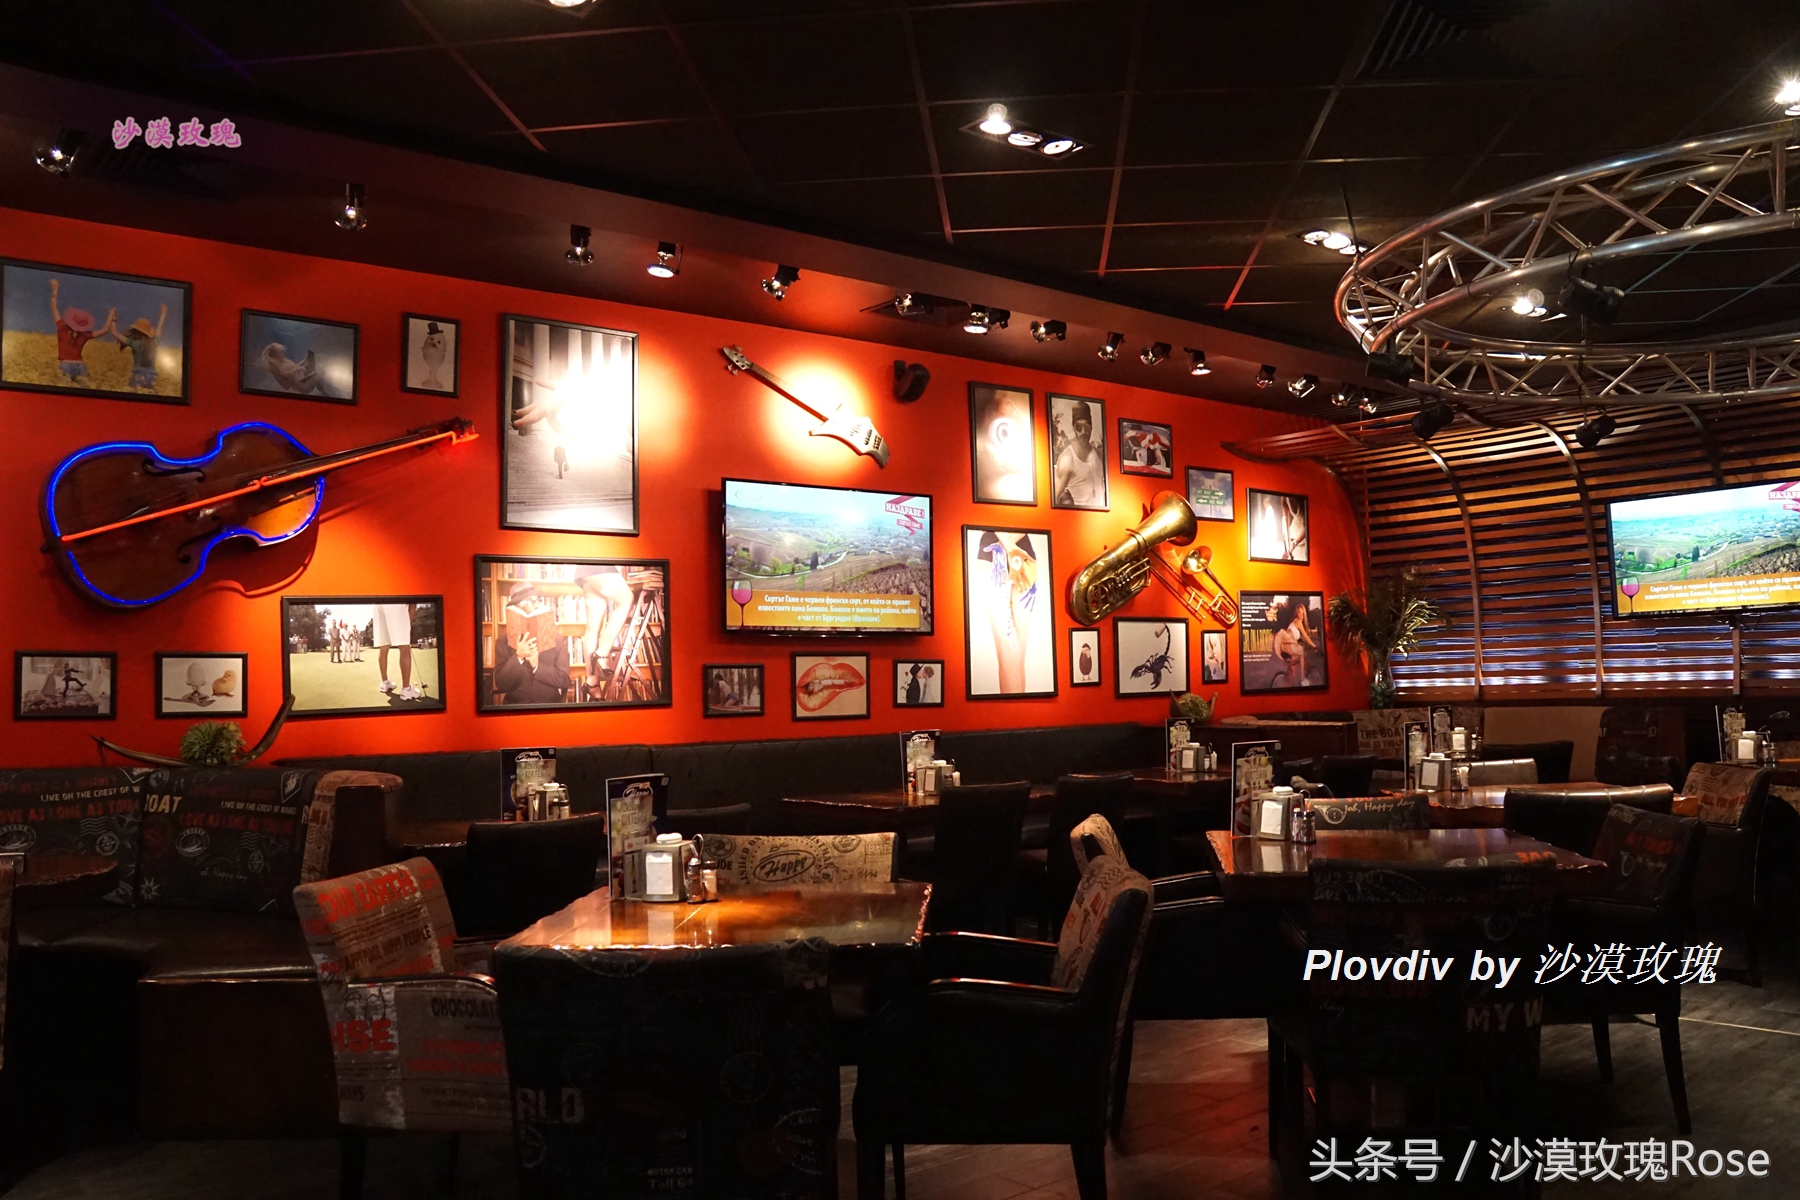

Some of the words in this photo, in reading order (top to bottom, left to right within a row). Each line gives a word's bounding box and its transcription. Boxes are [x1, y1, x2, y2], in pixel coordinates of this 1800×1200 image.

[41, 792, 60, 802] LIVE
[62, 792, 74, 801] ON
[76, 790, 92, 799] THE
[93, 788, 118, 798] CREST
[120, 786, 130, 795] OF
[144, 794, 183, 814] OAT
[245, 802, 256, 811] THE
[1364, 802, 1394, 812] Happy
[760, 856, 807, 878] Happy
[317, 887, 359, 923] OUR
[355, 869, 418, 912] EARTH
[402, 924, 432, 947] PEOPLE
[431, 997, 498, 1018] CHOCOLAT
[1466, 1003, 1514, 1032] MY
[676, 1167, 693, 1175] CAR
[647, 1178, 674, 1190] Toll
